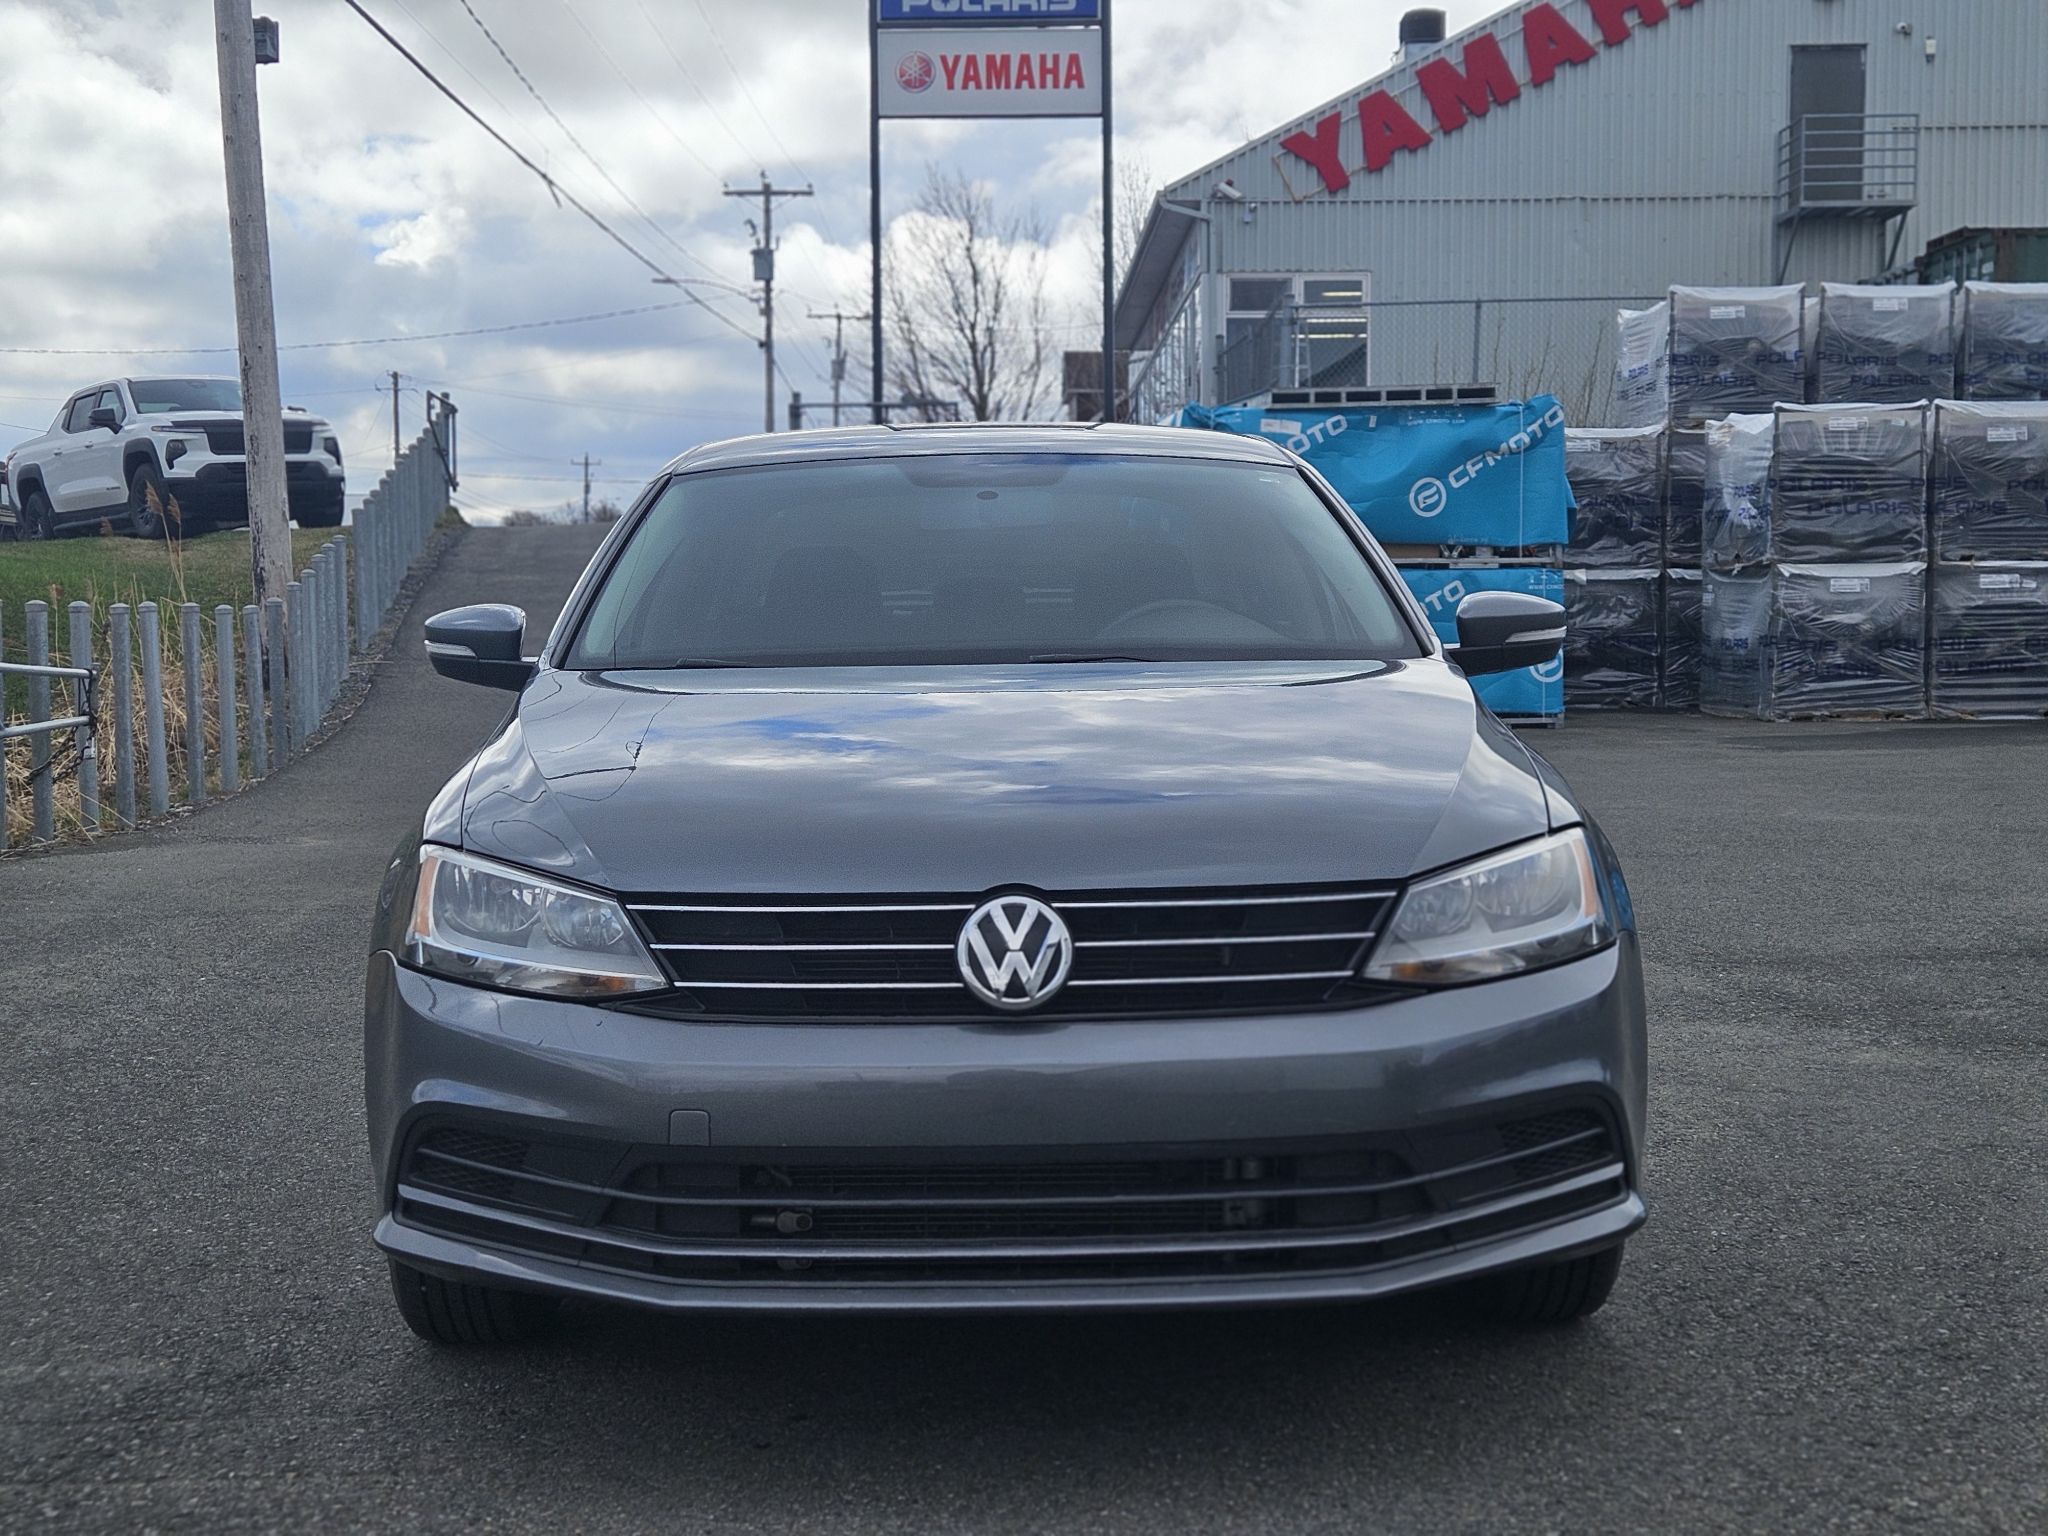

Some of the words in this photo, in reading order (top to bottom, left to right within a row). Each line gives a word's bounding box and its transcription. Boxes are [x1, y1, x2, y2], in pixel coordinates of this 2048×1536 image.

[940, 53, 1085, 90] YAMAHA
[1279, 0, 1698, 194] YAMAH
[1280, 414, 1348, 455] OTO
[1448, 405, 1565, 489] CFMOTO
[1419, 579, 1467, 616] TO
[966, 901, 1062, 1001] VW
